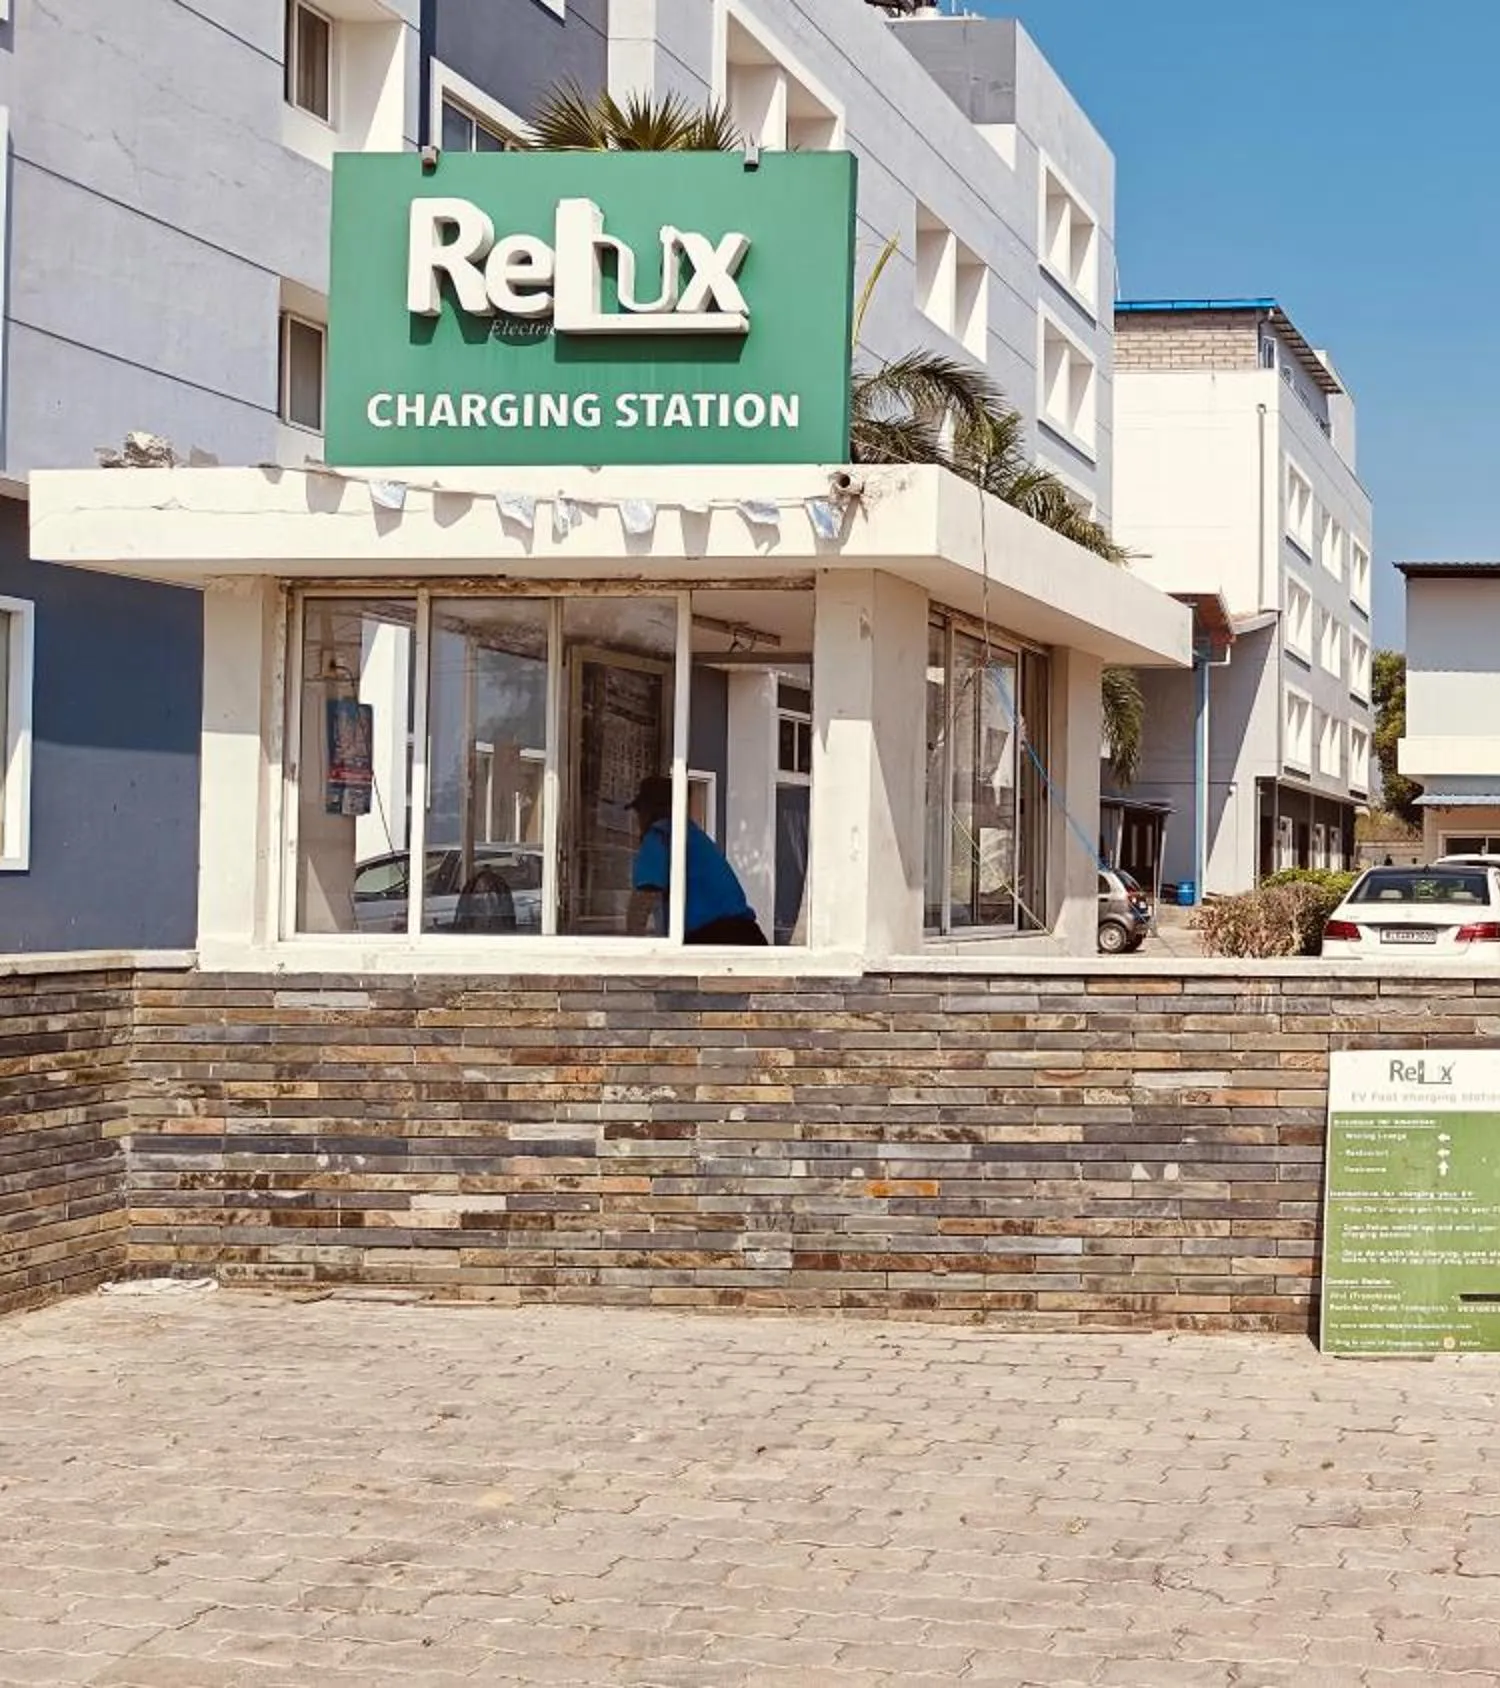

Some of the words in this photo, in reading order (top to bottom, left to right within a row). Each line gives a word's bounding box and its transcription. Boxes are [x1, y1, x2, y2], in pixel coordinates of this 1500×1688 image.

[366, 392, 602, 428] CHARGING
[615, 392, 799, 428] STATION
[1389, 1059, 1453, 1084] ReLx
